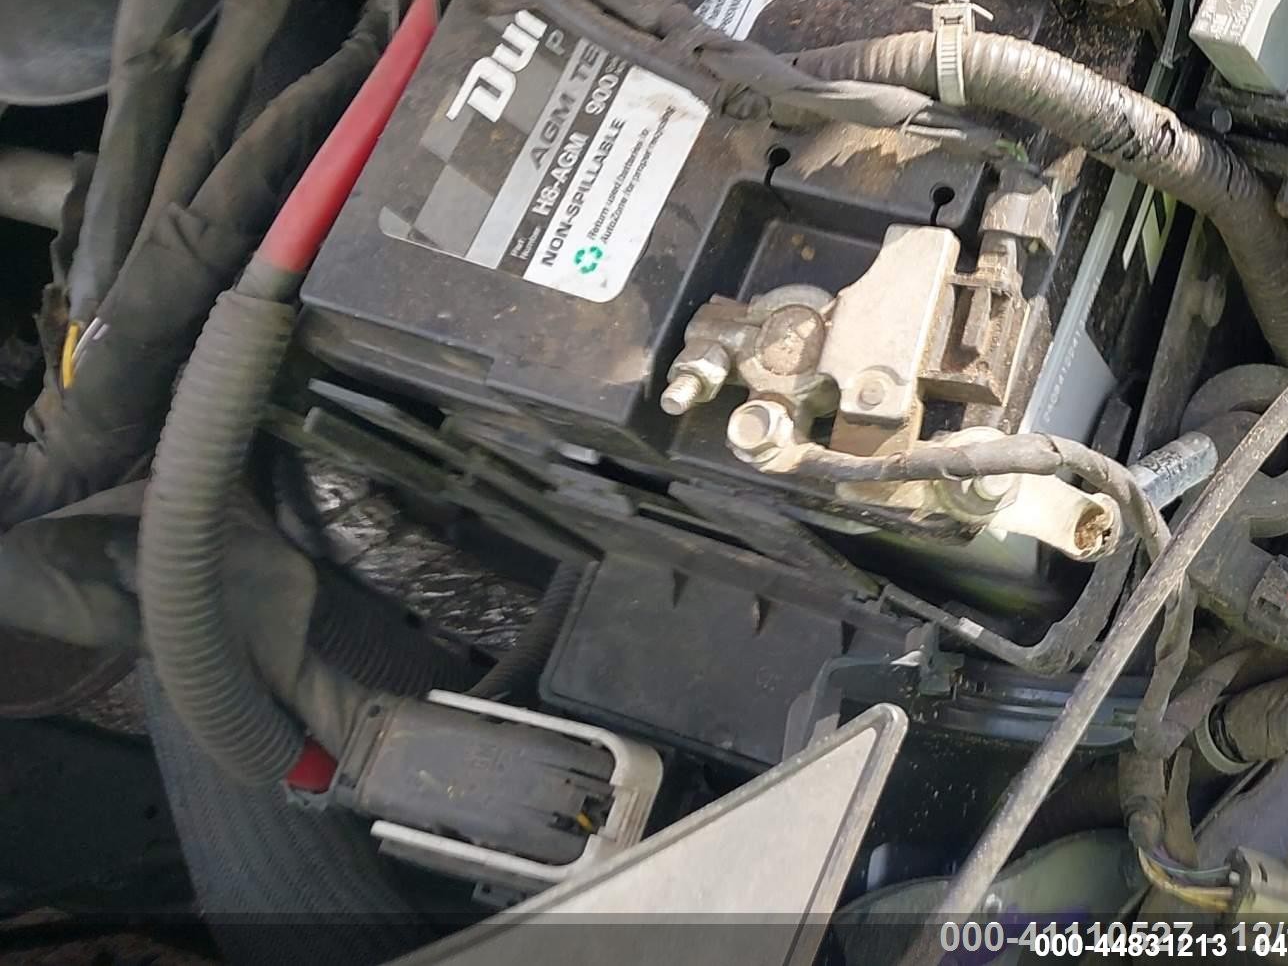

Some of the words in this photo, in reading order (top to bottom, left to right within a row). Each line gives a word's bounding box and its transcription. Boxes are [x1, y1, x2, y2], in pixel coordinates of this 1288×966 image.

[530, 92, 575, 170] AGM
[532, 132, 590, 216] H8-AGM
[585, 73, 619, 115] 900
[541, 117, 627, 266] NON-SPILLABLE
[601, 196, 629, 245] AutoZone
